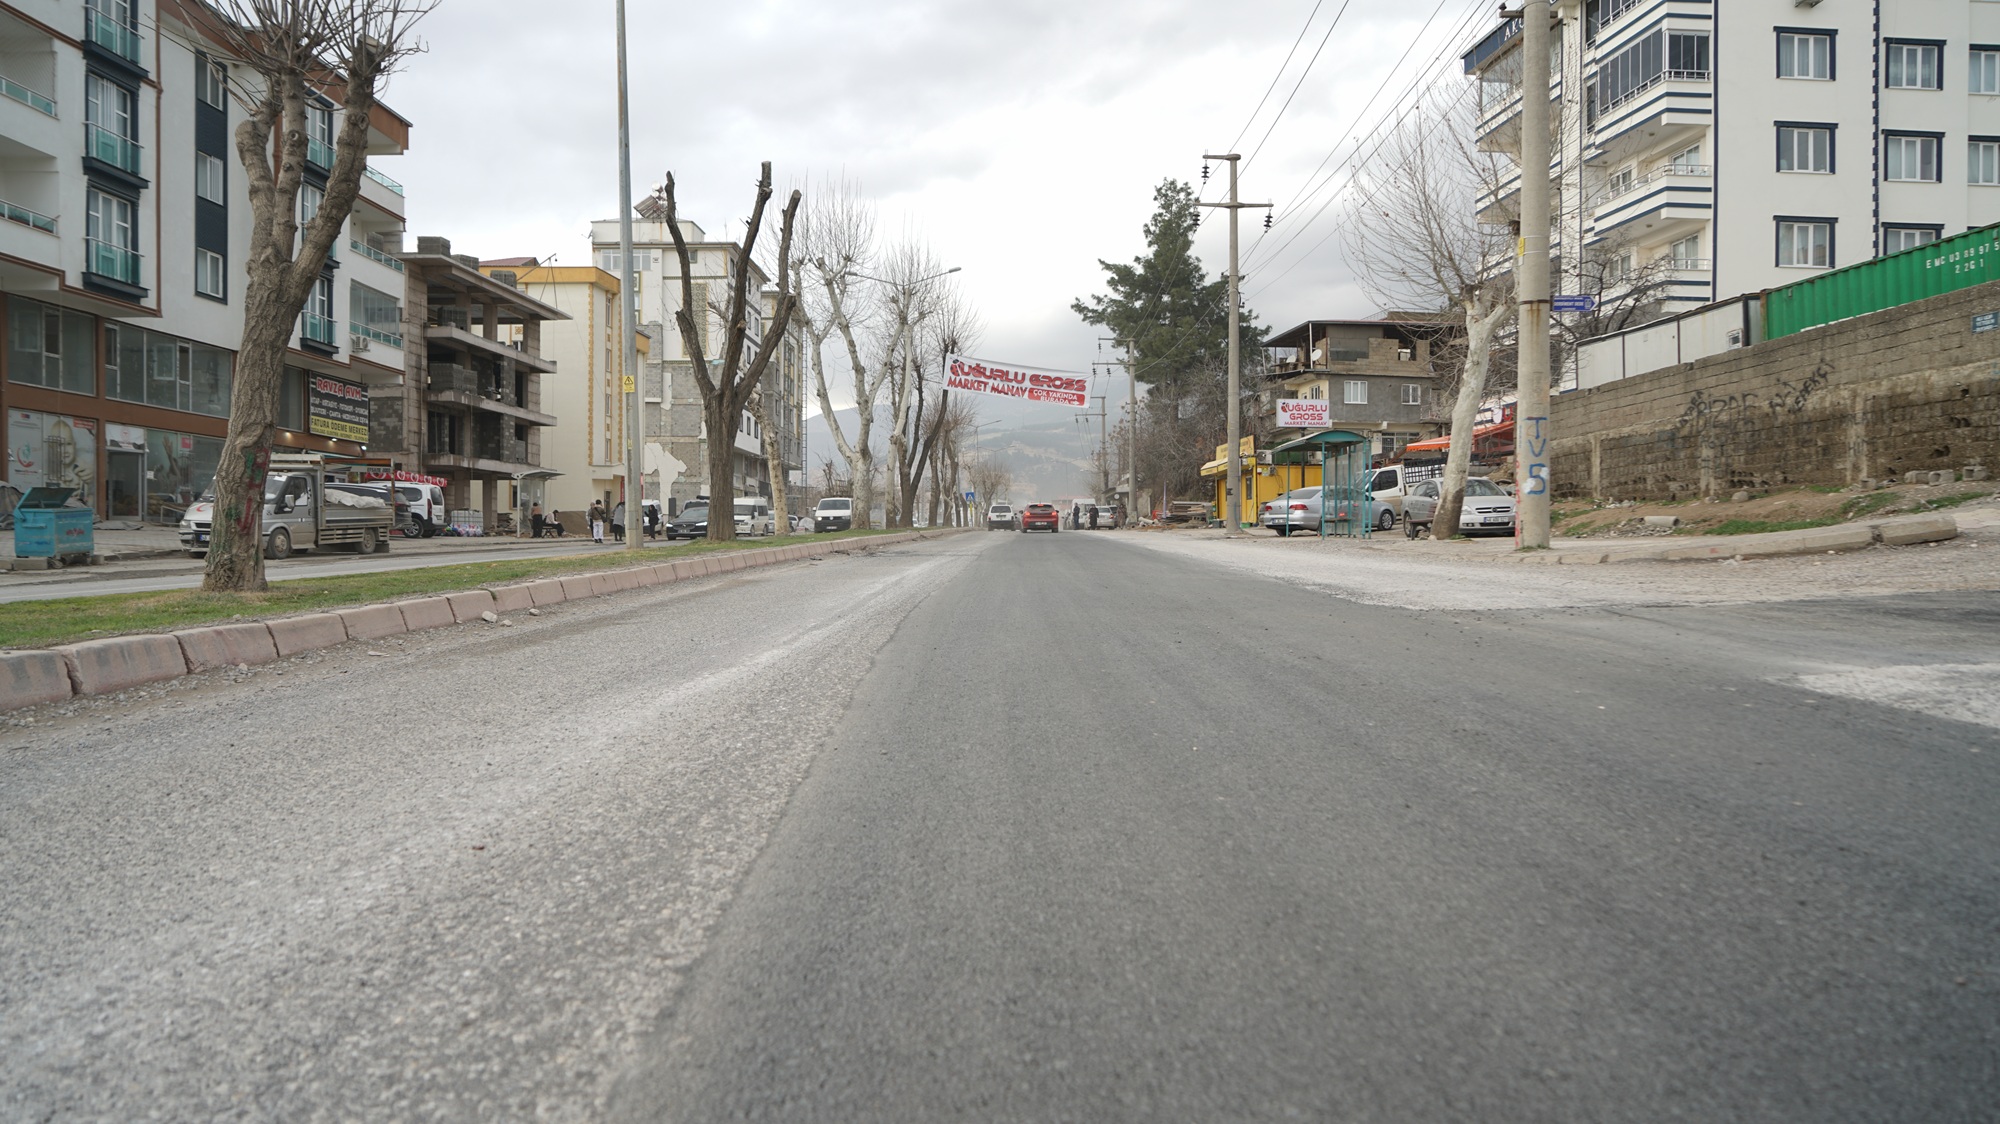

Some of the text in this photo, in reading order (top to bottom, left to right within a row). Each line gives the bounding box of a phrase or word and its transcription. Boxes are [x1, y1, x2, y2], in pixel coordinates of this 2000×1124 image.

[959, 363, 1086, 392] UĞURLU GROSS
[316, 377, 362, 401] RAVZA AVM
[947, 376, 1028, 398] MARKET MANAV
[1033, 389, 1078, 400] ÇOK YAKINDA
[1040, 396, 1069, 405] BURADA
[1287, 402, 1328, 412] UĞURLU
[1289, 413, 1323, 421] GROSS
[311, 417, 330, 430] FATURA
[330, 420, 348, 433] ÖDEME
